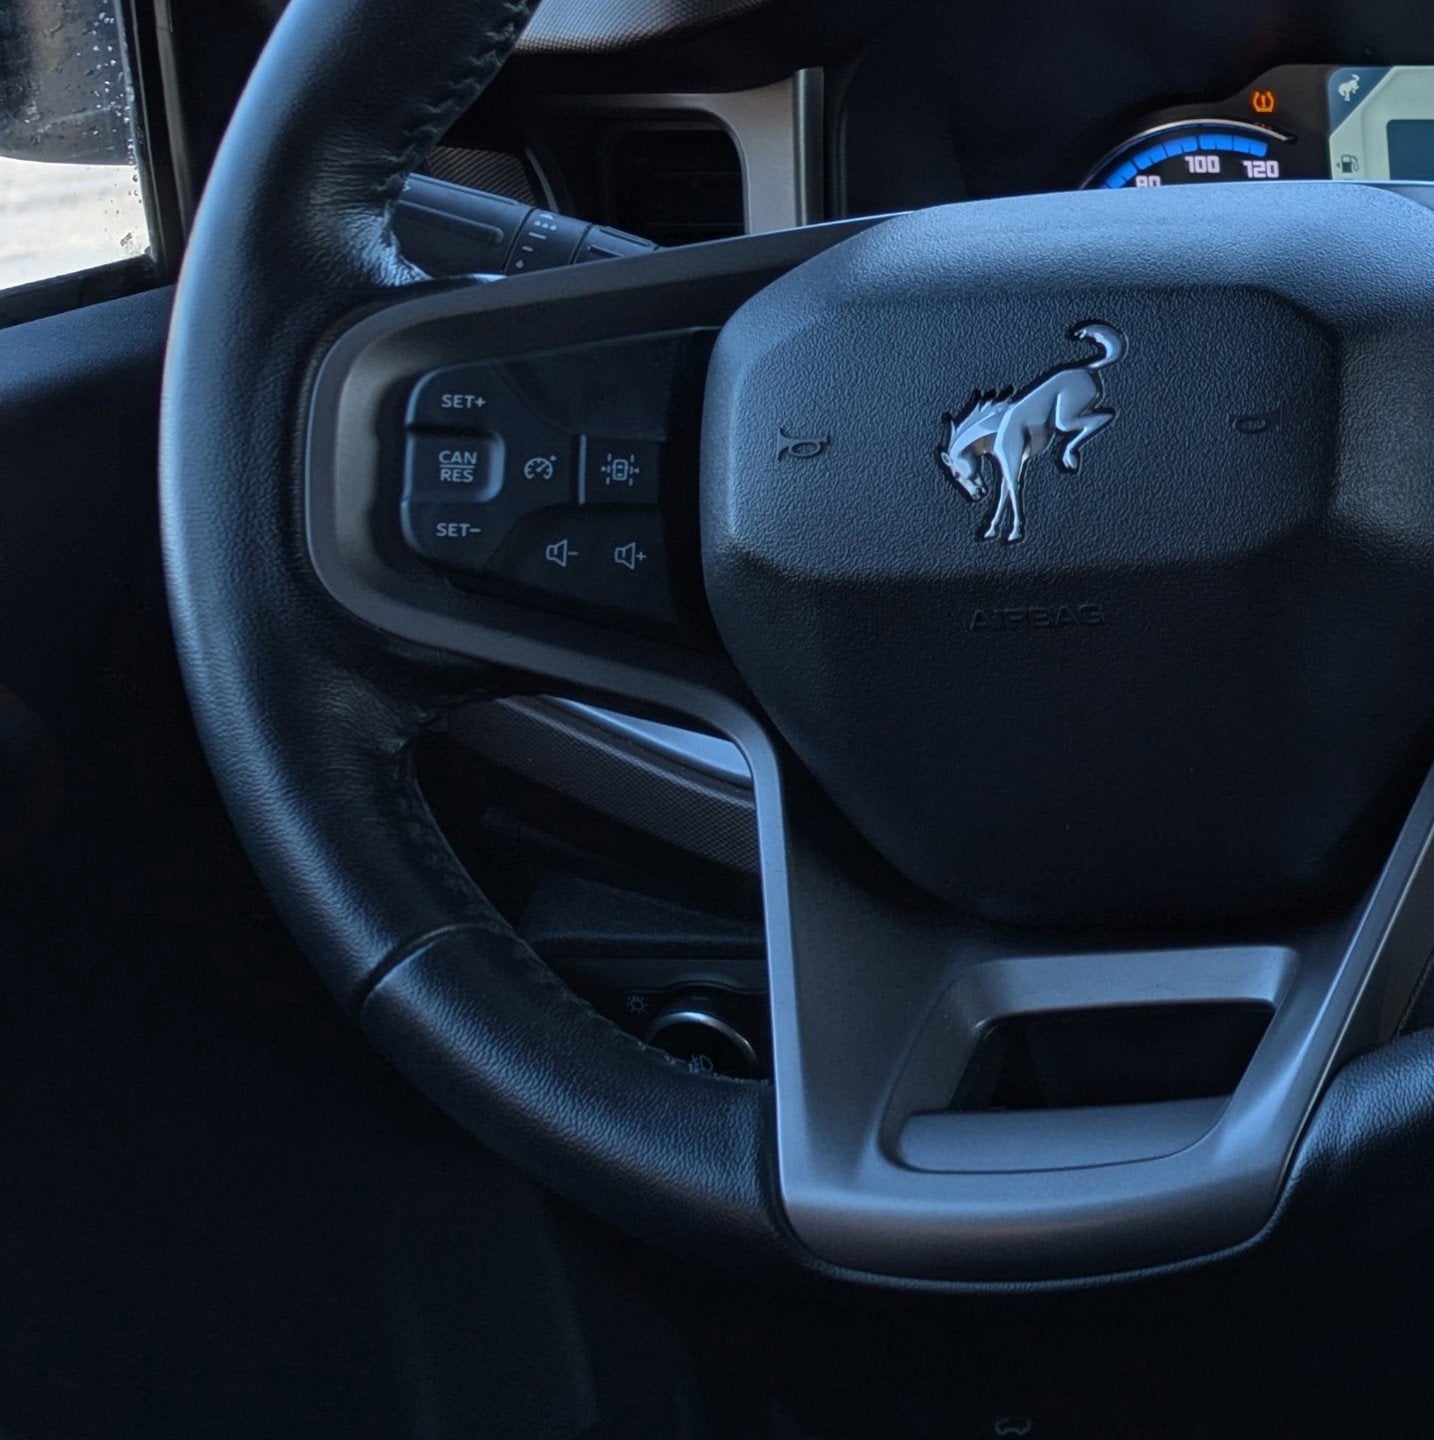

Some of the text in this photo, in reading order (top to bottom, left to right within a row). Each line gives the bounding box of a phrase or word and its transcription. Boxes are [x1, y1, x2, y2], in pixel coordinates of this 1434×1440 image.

[1185, 155, 1280, 179] 100 120
[441, 394, 487, 409] SET+
[438, 451, 478, 465] CAN
[440, 469, 474, 483] RES
[969, 603, 1104, 631] AIRBAG
